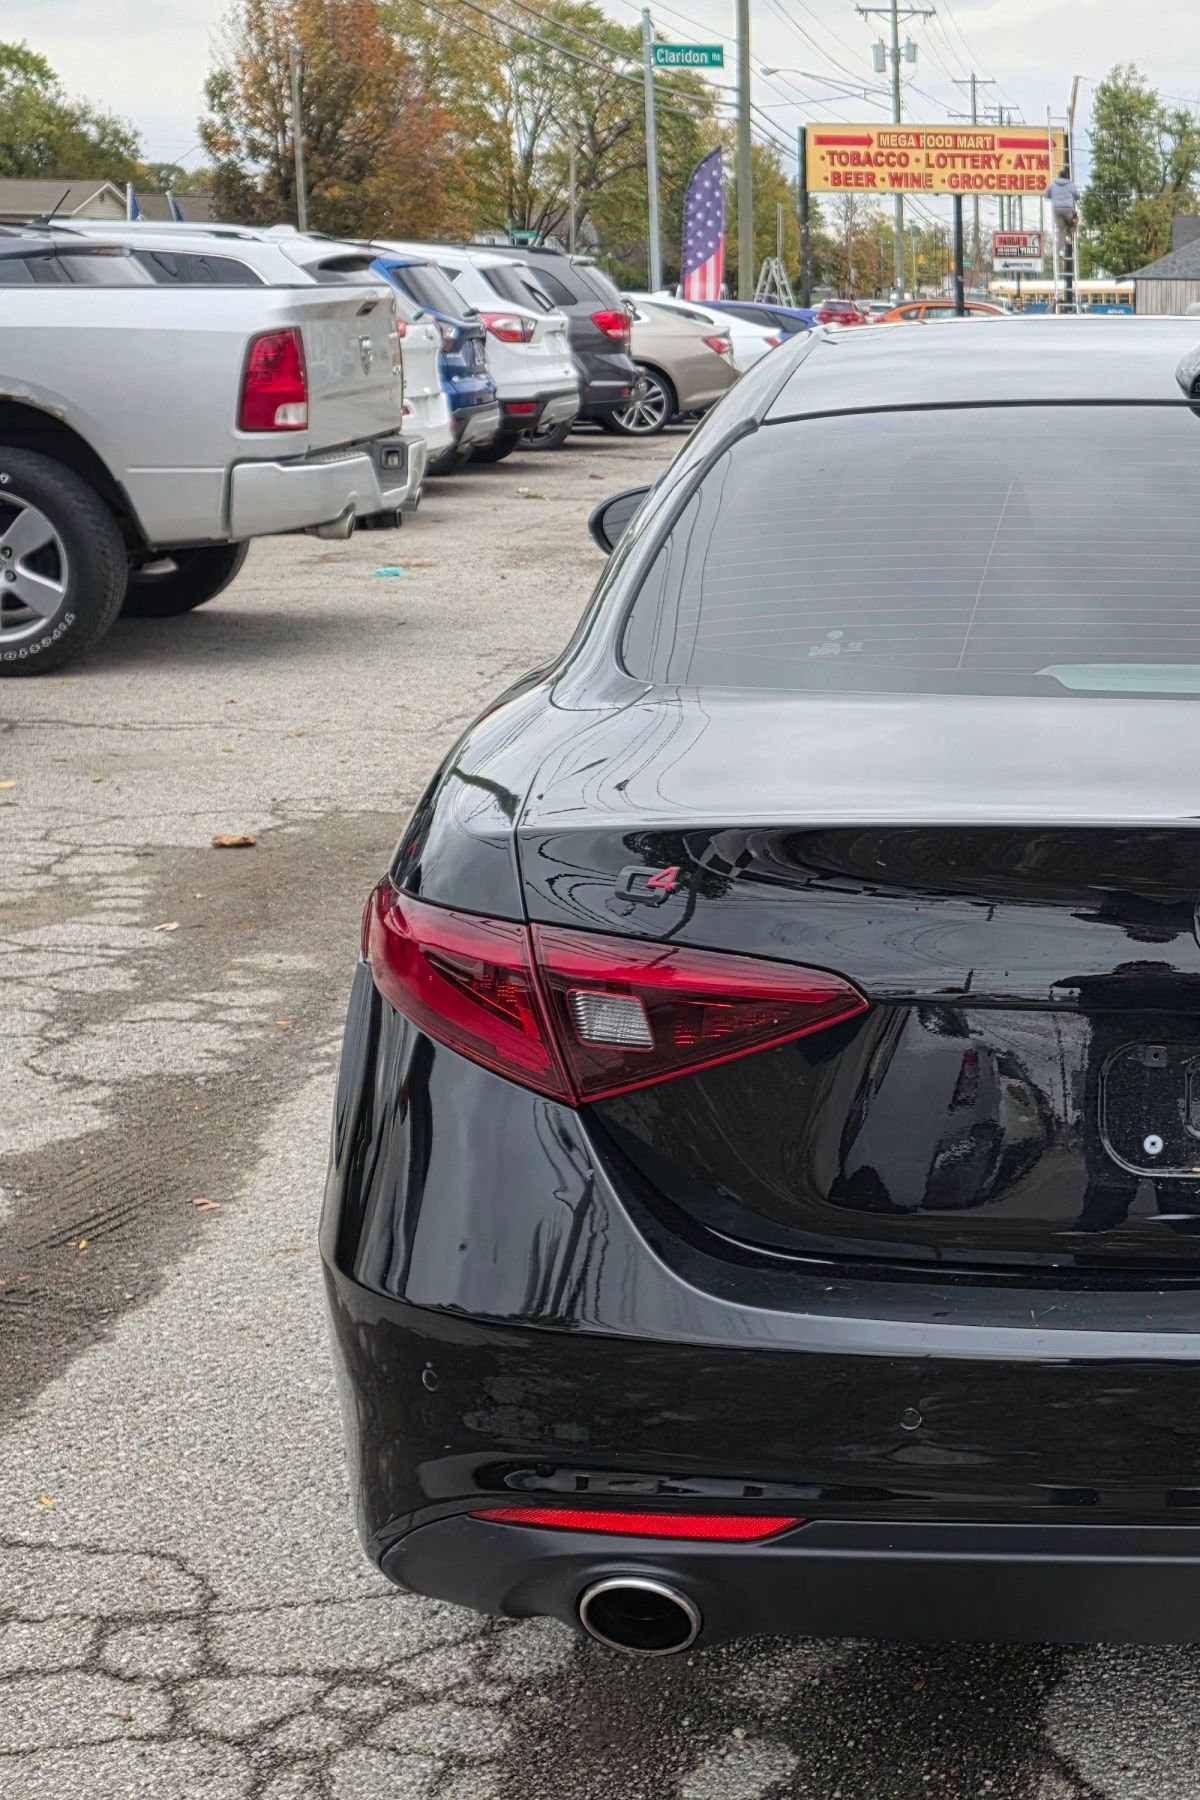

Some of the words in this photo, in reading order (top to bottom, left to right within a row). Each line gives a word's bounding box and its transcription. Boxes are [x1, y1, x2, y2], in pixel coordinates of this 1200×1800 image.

[656, 48, 708, 63] Claridon
[879, 134, 915, 148] MEGA
[919, 135, 953, 149] FOOD
[957, 136, 992, 149] MART
[826, 150, 910, 168] TOBACCO
[925, 152, 1003, 170] LOTTERY
[1013, 154, 1050, 171] ATM
[830, 171, 876, 188] BEER
[888, 172, 933, 189] WINE
[947, 173, 1047, 190] GROCERIES
